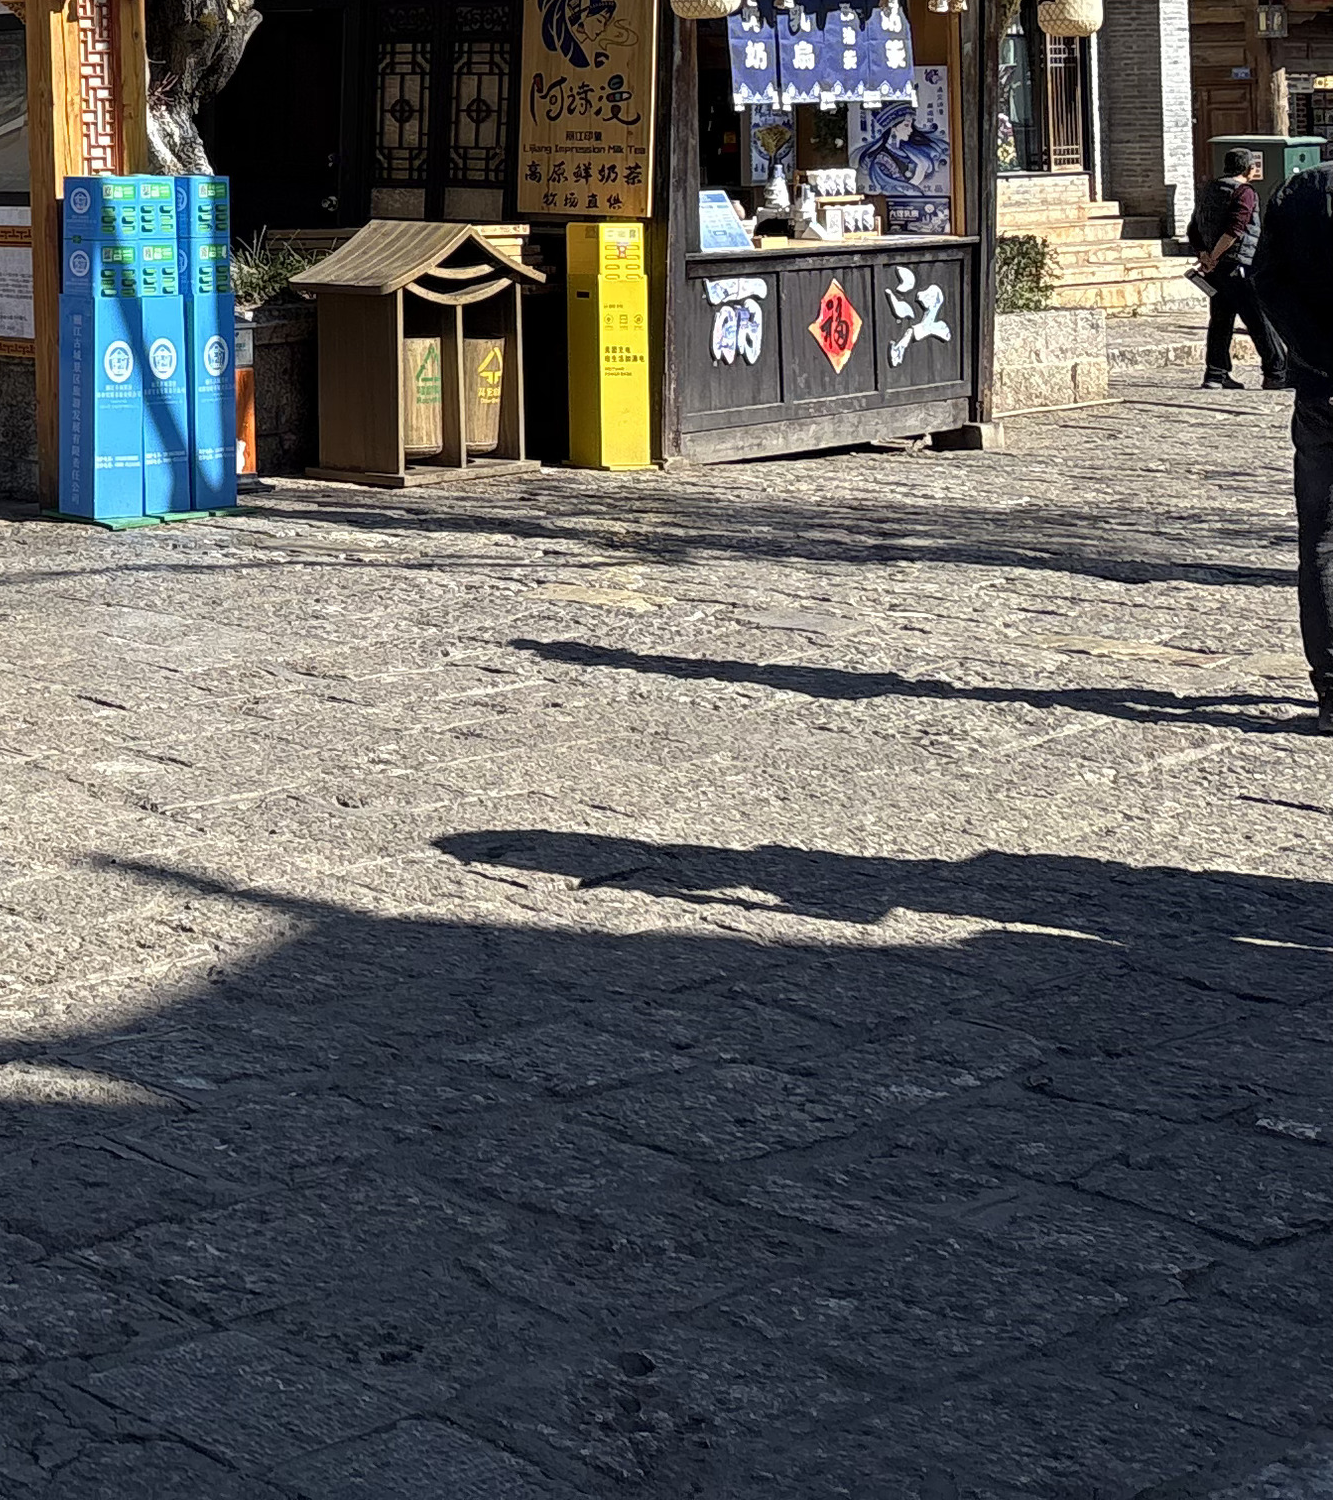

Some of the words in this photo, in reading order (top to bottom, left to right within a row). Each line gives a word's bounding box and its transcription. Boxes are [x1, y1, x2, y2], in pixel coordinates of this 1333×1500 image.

[565, 130, 603, 142] 丽江印象
[523, 145, 552, 155] Lijiang
[554, 144, 606, 154] Impression
[607, 144, 625, 154] Milk
[627, 145, 646, 155] Tea
[524, 160, 643, 186] 高原鲜奶茶
[542, 192, 623, 211] 牧场直供
[704, 278, 768, 365] 丽
[885, 266, 951, 368] 江
